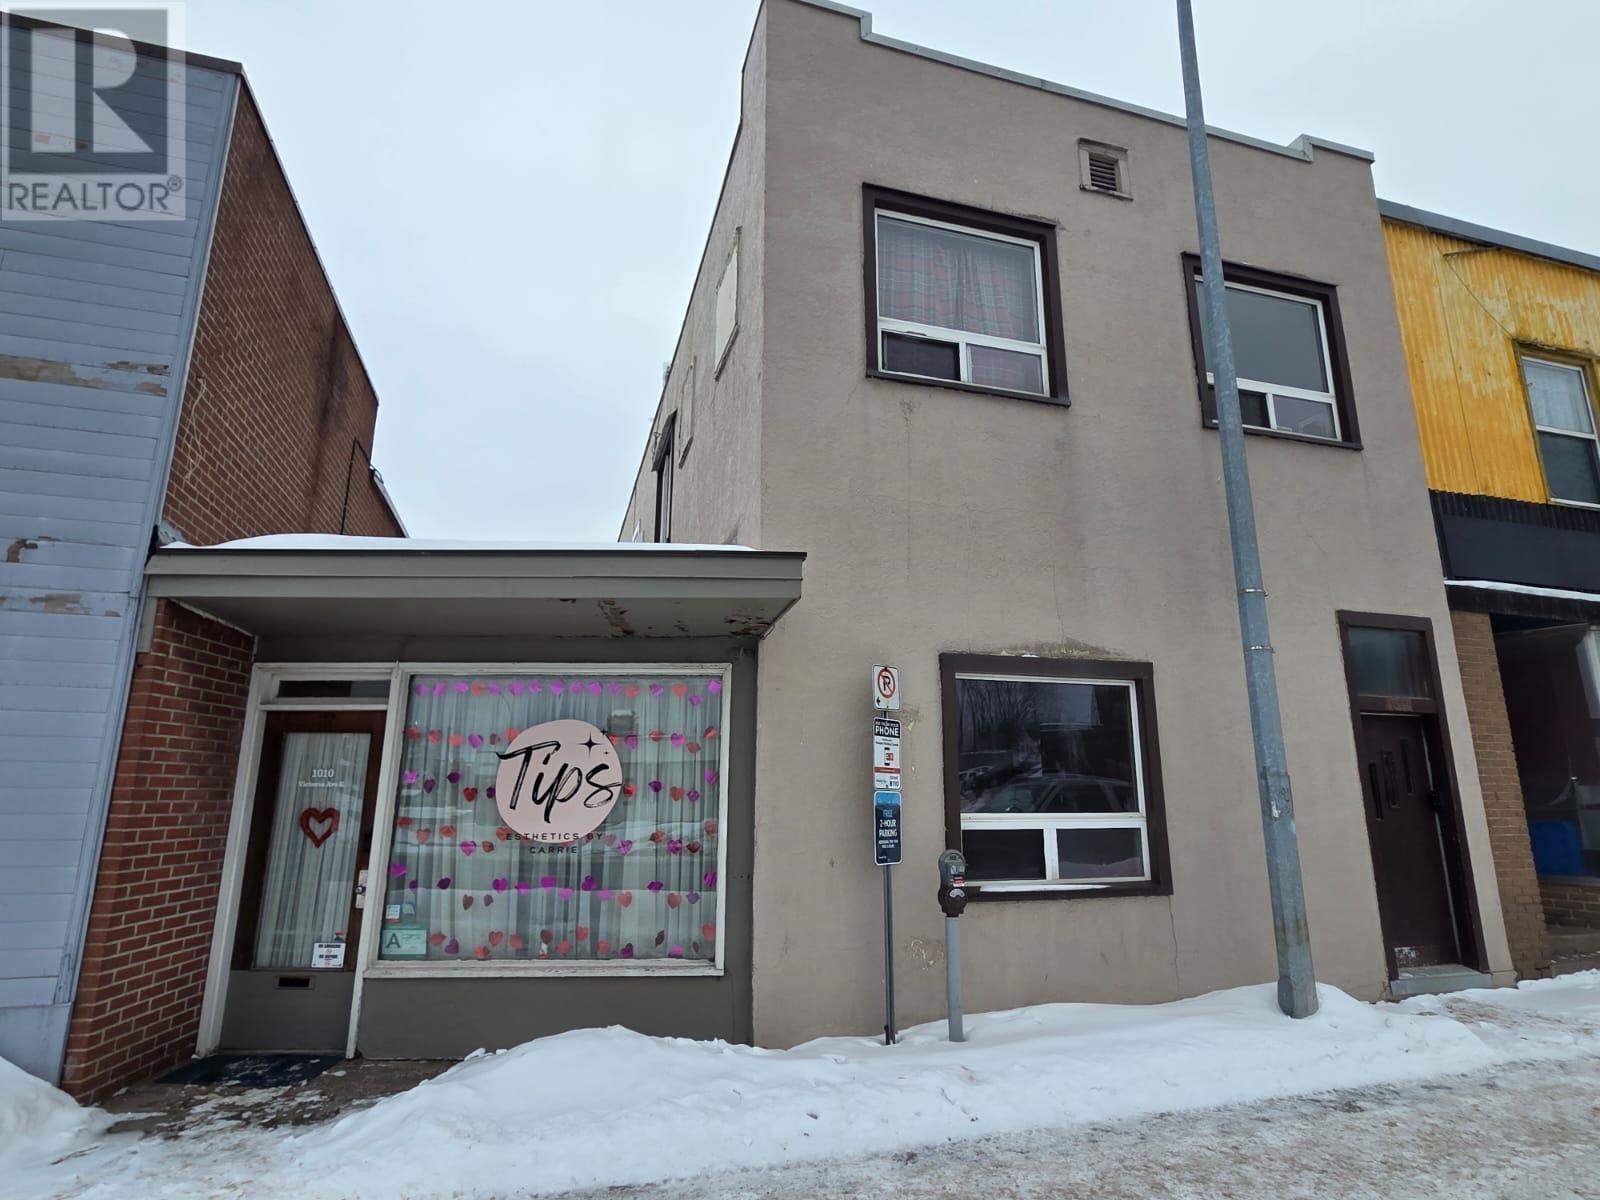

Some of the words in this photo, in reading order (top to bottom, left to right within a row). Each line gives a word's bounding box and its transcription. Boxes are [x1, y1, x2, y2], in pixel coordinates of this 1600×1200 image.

[875, 725, 900, 736] PHONE
[312, 768, 335, 778] 1010
[496, 741, 623, 824] Tips
[880, 819, 897, 828] 2-HOUR
[506, 832, 580, 841] ESTHETICS
[586, 832, 604, 841] BY
[879, 829, 897, 838] PARKING
[529, 846, 578, 854] CARRIE
[385, 932, 401, 949] A
